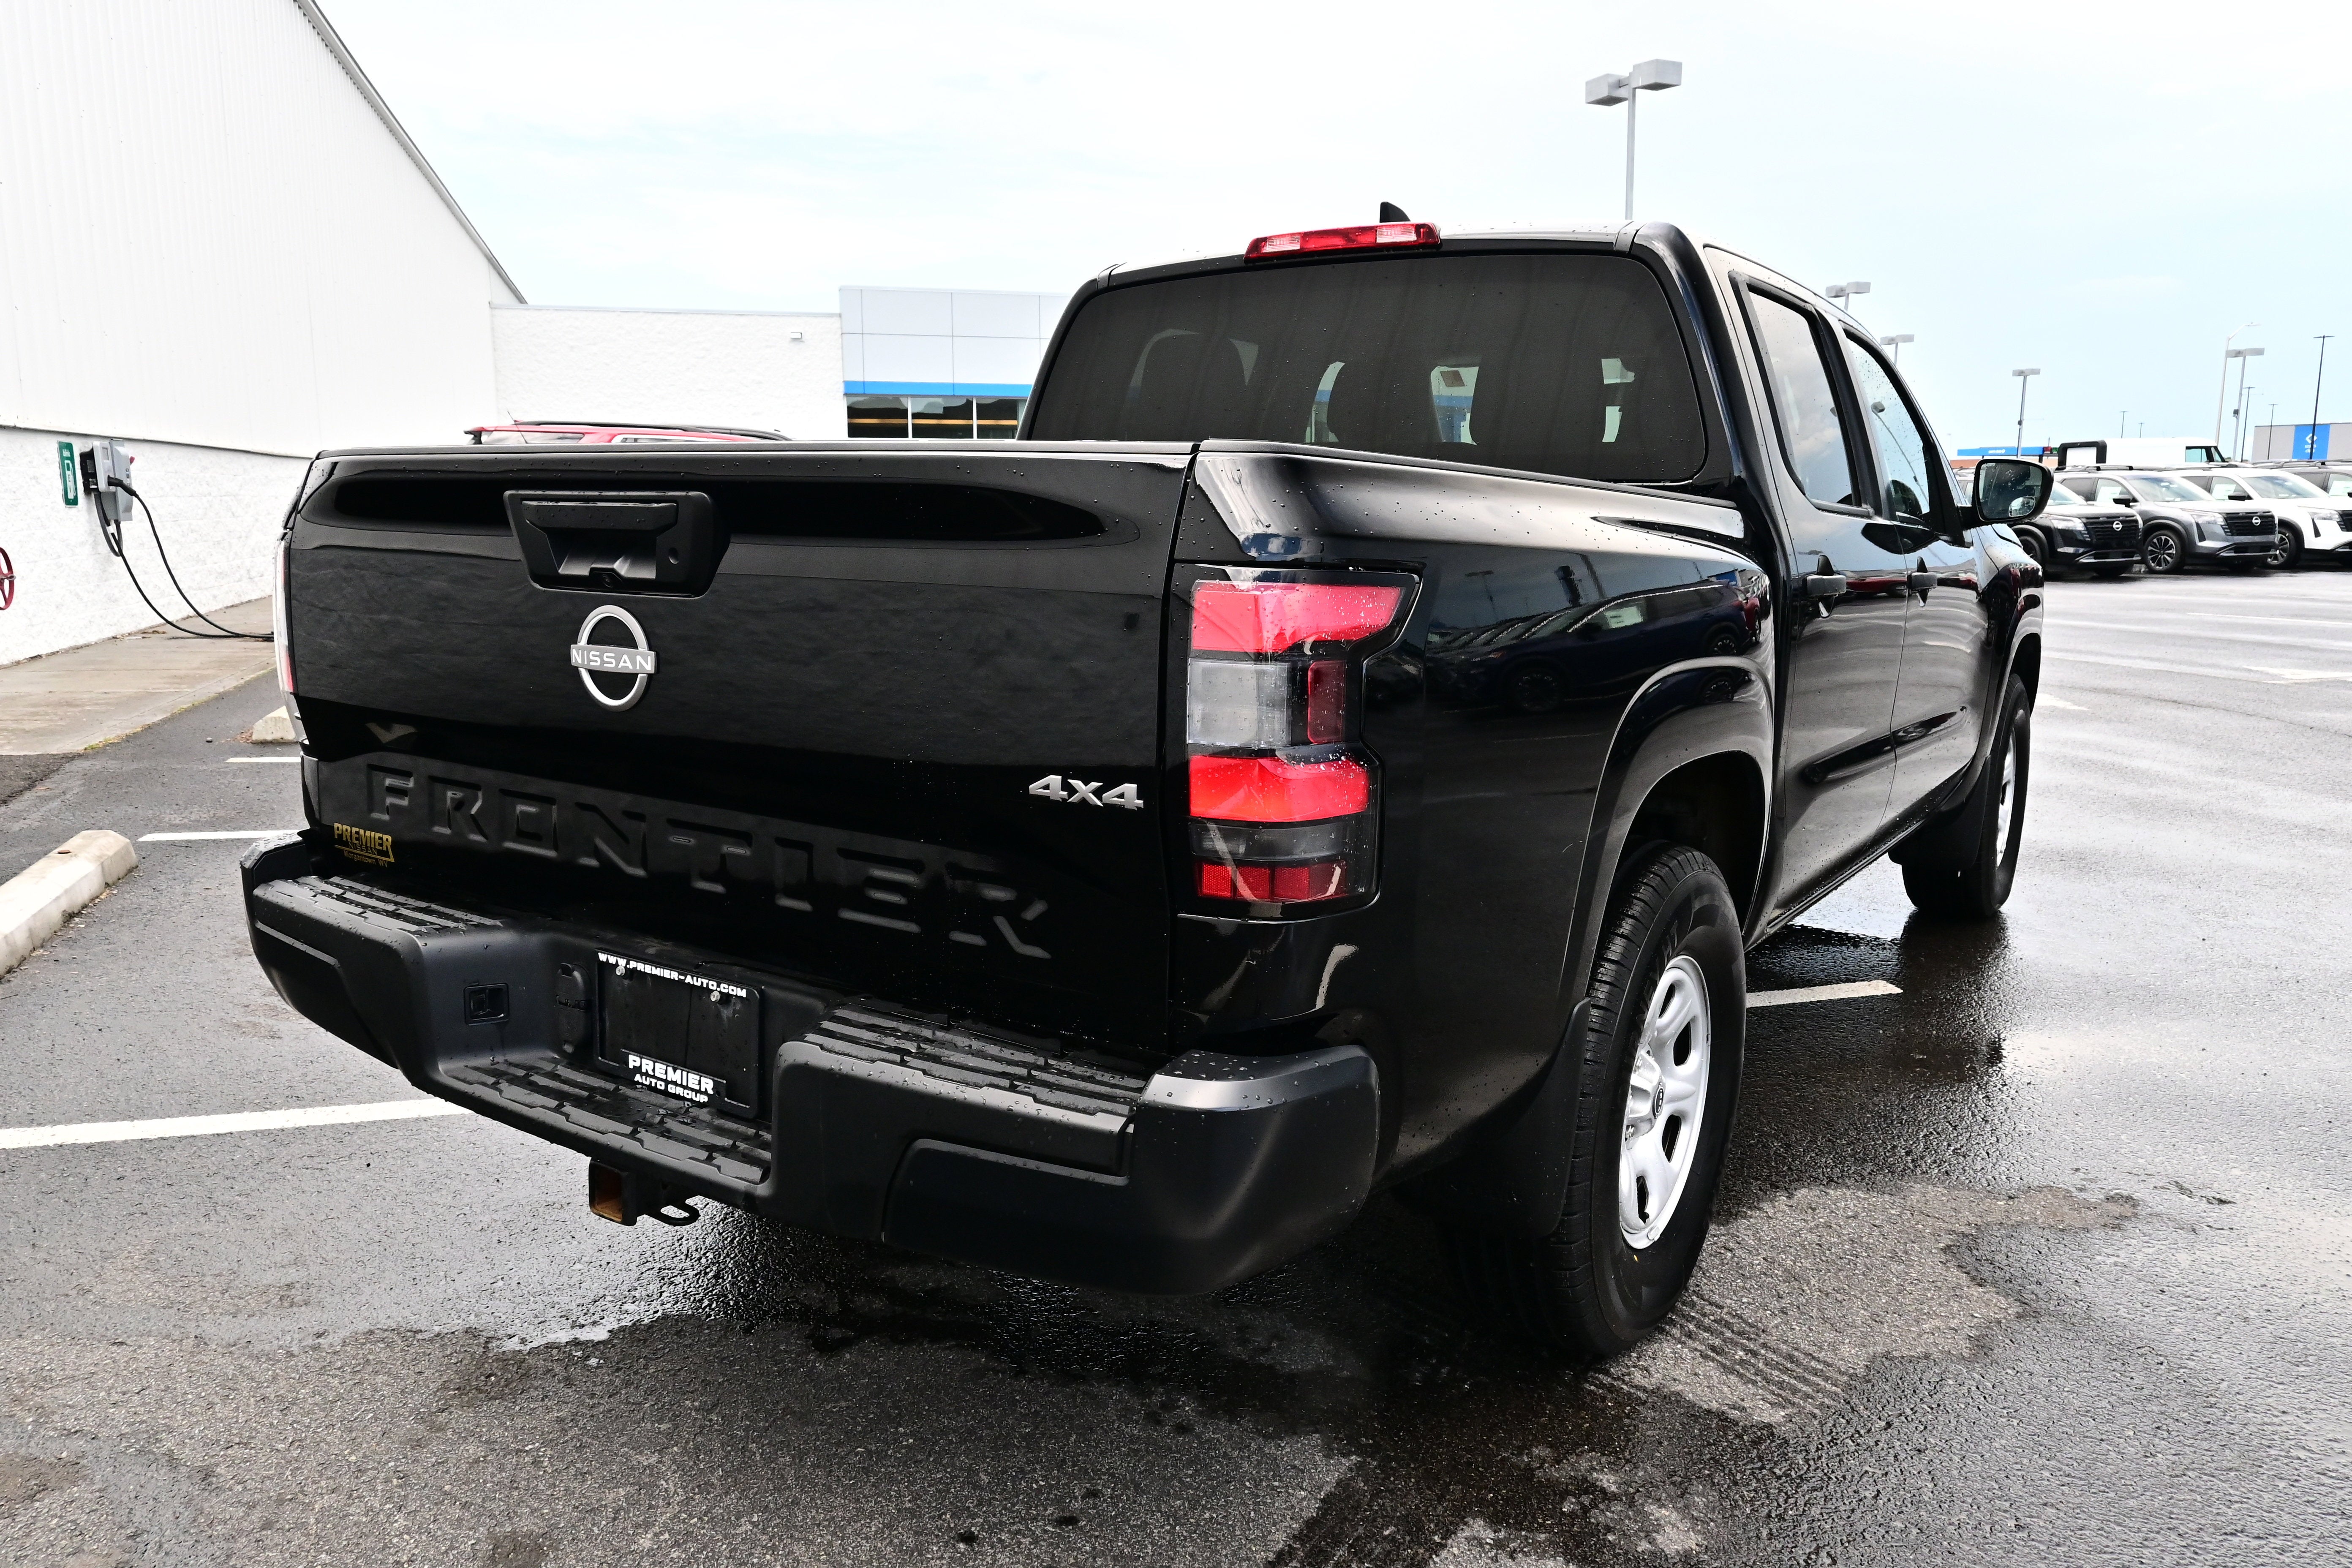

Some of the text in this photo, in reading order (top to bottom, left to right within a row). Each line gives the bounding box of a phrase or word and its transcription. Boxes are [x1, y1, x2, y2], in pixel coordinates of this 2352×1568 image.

[572, 648, 652, 671] NISSAN
[334, 822, 392, 851] PREMIER
[348, 842, 378, 855] NISSAN
[343, 850, 388, 868] Morgantown WV
[366, 762, 1053, 960] FRONTIER
[598, 952, 747, 998] WWW.PREMIER-AUTO.COM
[628, 1054, 714, 1095] PREMIER
[634, 1073, 708, 1103] AUTO GROUP
